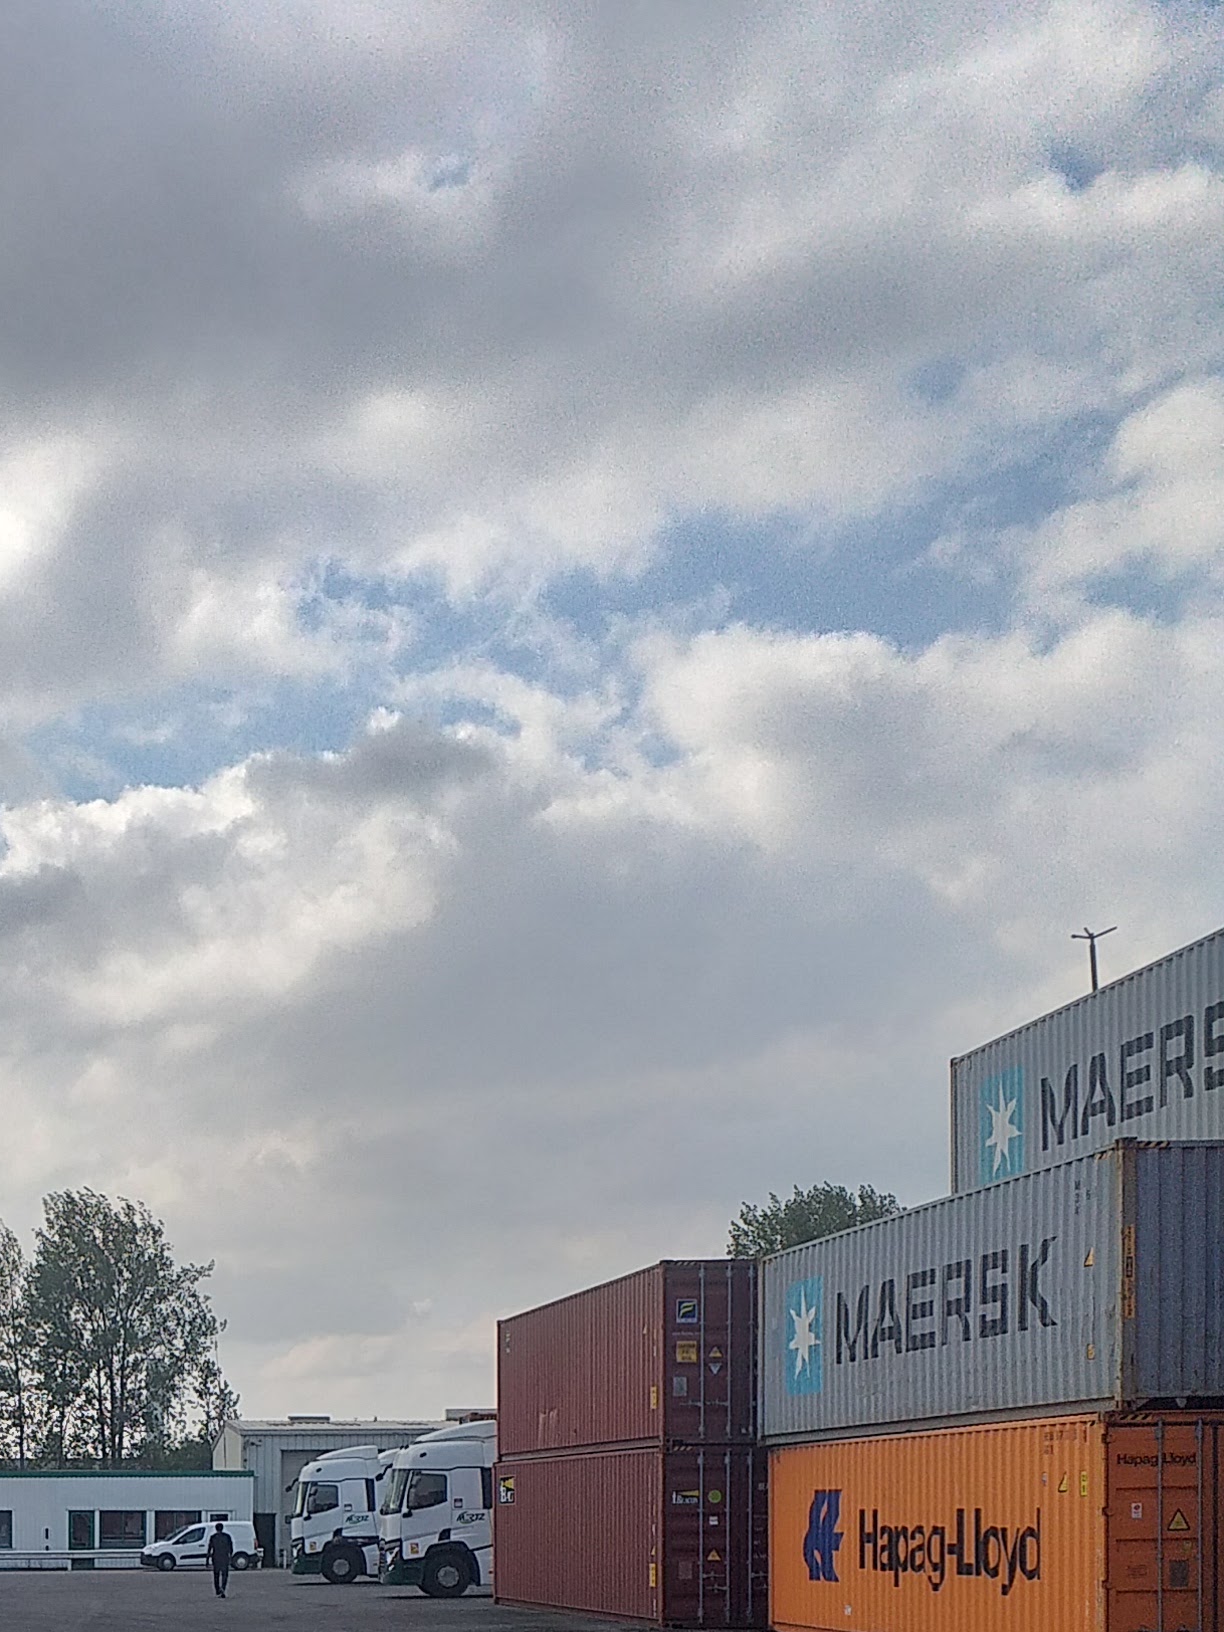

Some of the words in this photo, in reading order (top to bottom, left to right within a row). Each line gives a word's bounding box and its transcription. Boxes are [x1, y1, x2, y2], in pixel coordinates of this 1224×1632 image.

[836, 1235, 1058, 1365] MAERSK
[1116, 1452, 1197, 1468] HapagLloyd
[859, 1507, 1041, 1596] Hapag-Lloyd
